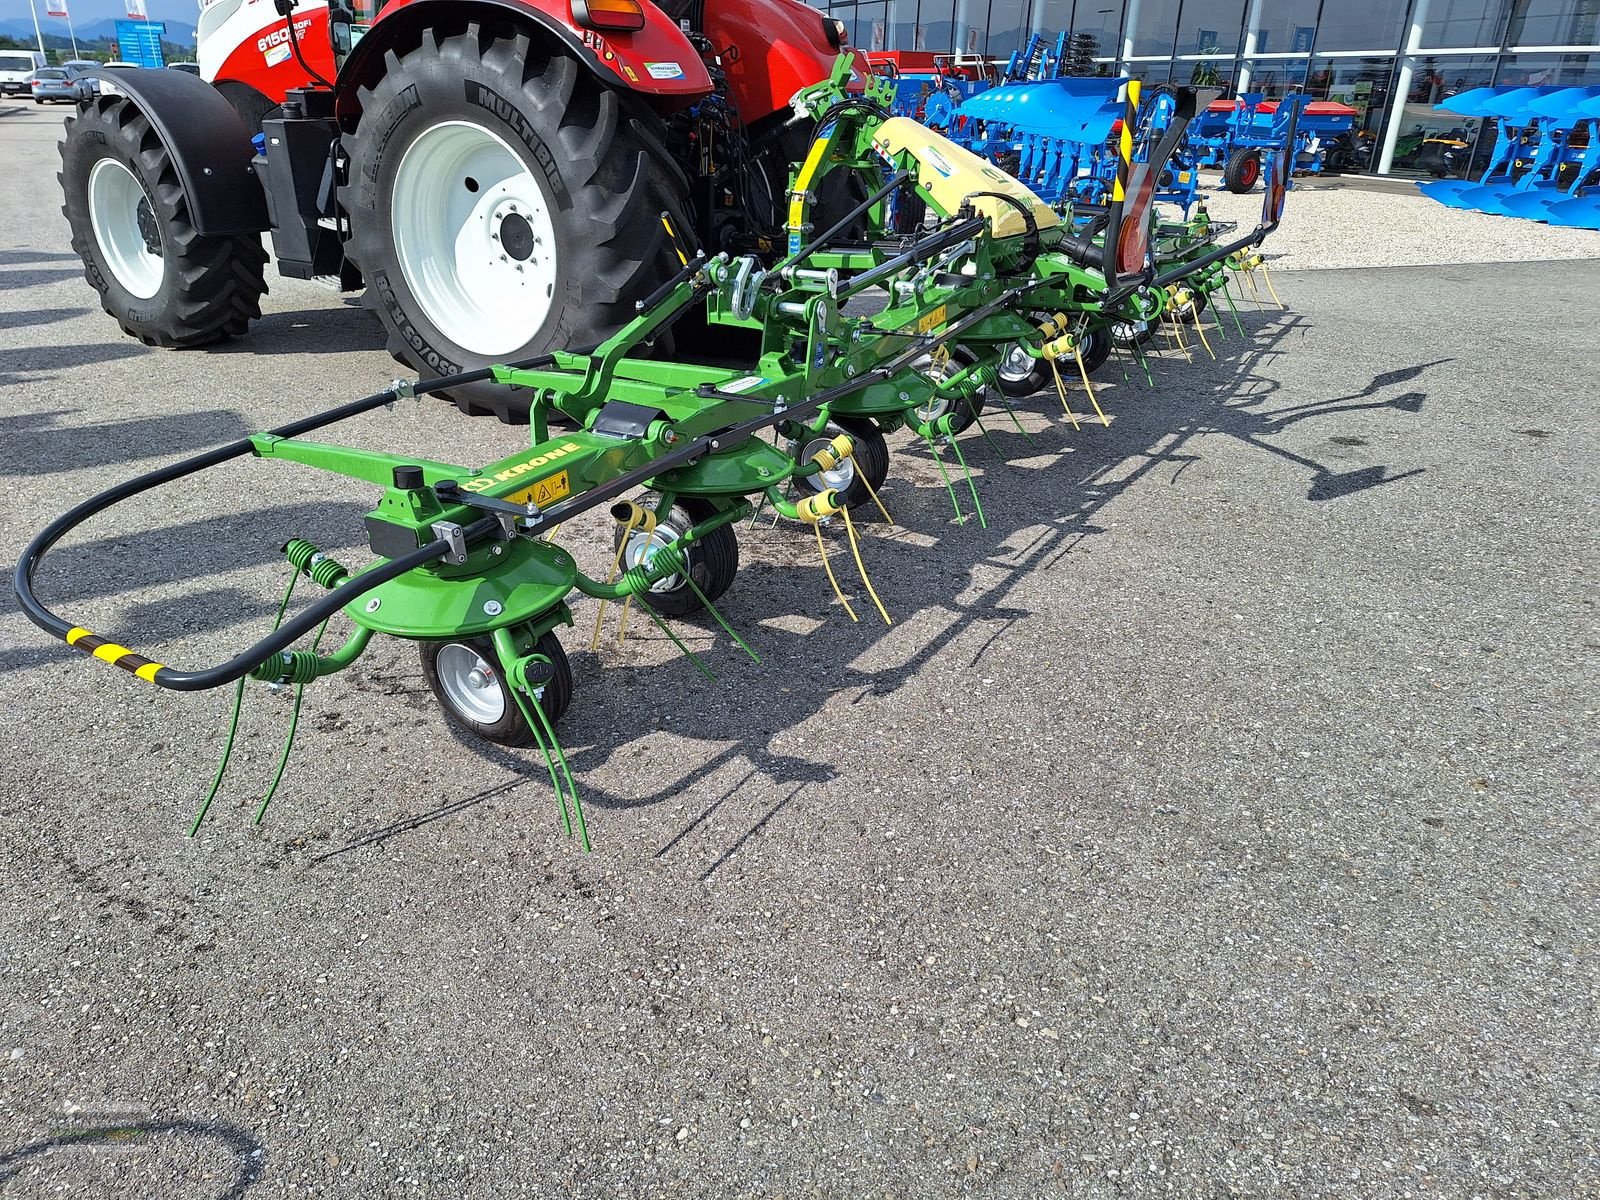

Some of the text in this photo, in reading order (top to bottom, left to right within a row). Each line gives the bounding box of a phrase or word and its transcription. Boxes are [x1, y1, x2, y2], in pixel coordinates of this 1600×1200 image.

[257, 19, 312, 52] 6150 ROFI
[478, 86, 563, 195] MULTIBIB
[376, 276, 457, 376] 650/65 R 38
[493, 441, 582, 482] KRONE
